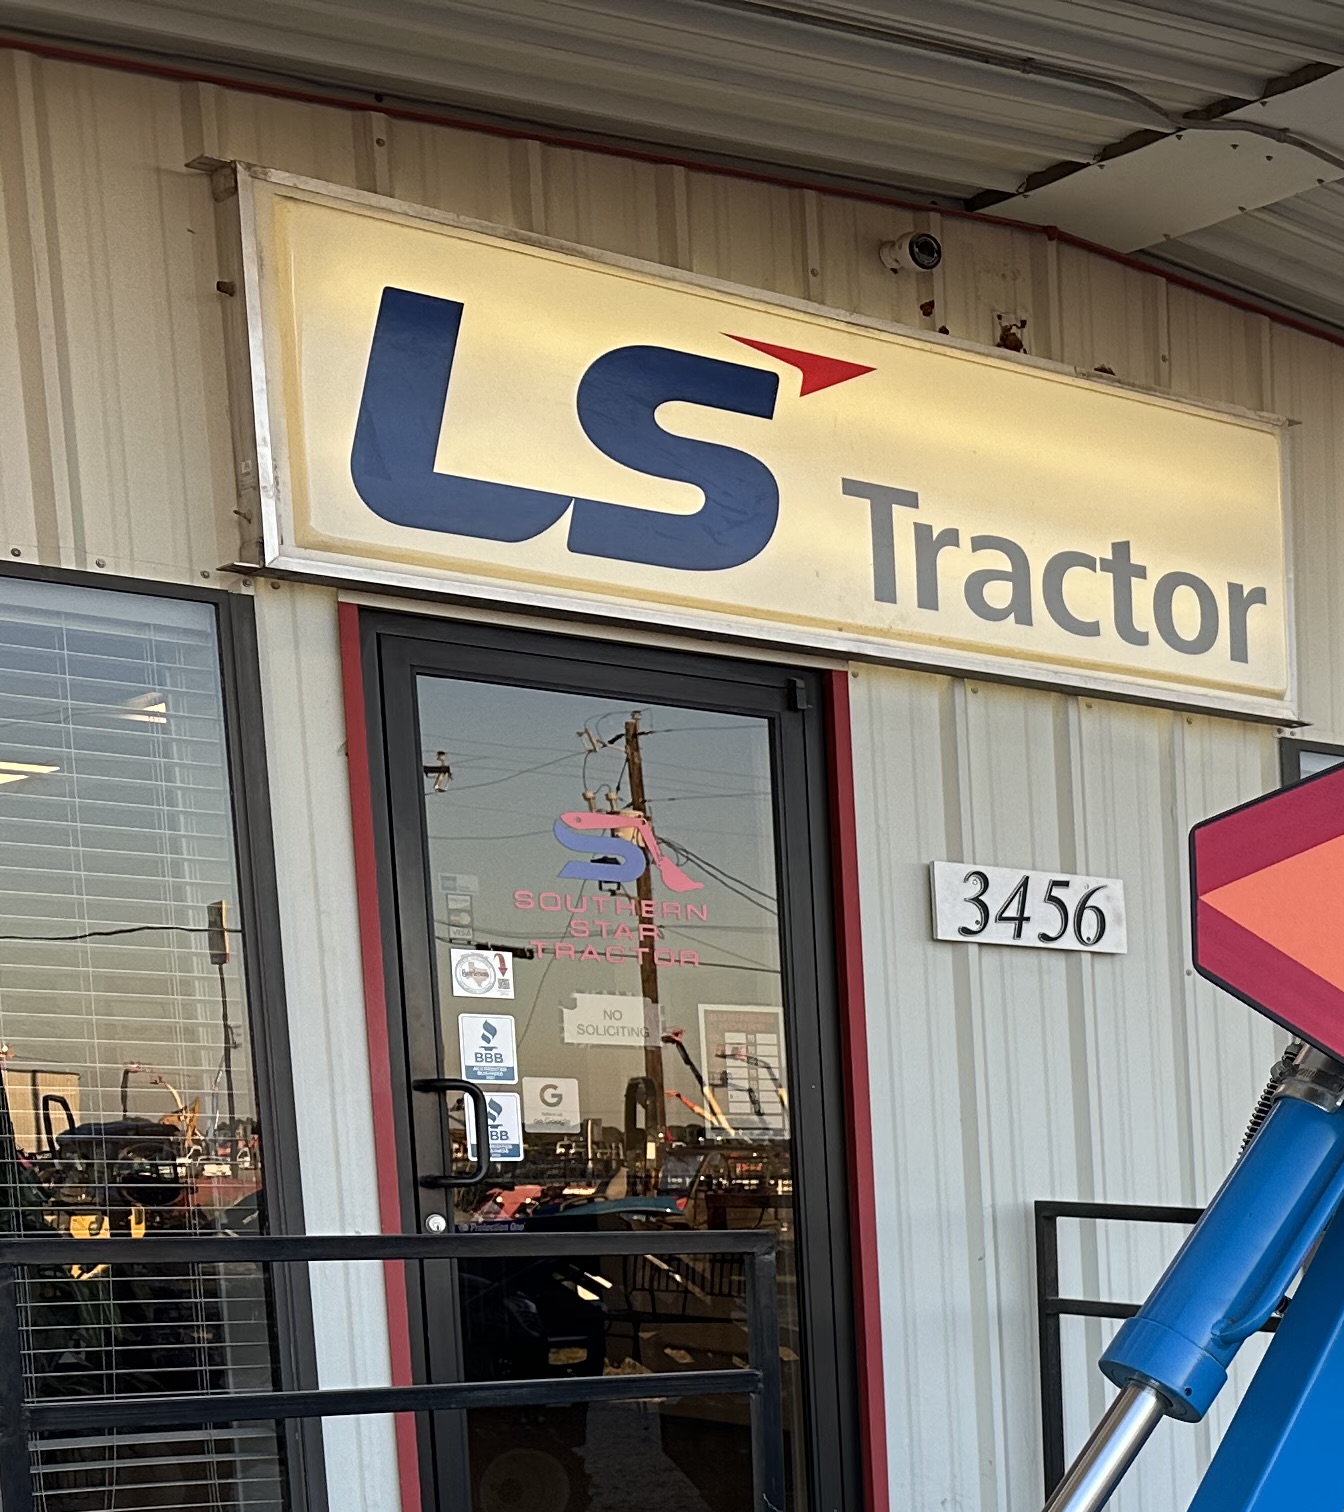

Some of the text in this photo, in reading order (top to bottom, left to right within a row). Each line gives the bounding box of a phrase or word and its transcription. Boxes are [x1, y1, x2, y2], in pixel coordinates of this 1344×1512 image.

[350, 286, 1267, 664] LS Tractor
[514, 890, 708, 921] SOUTHERN
[958, 870, 1108, 946] 3456
[569, 919, 659, 941] STAR
[530, 940, 700, 967] TRACTOR
[603, 1009, 623, 1021] NO
[576, 1023, 650, 1038] SOLICITING
[474, 1052, 504, 1063] BBB
[490, 1130, 509, 1141] BB
